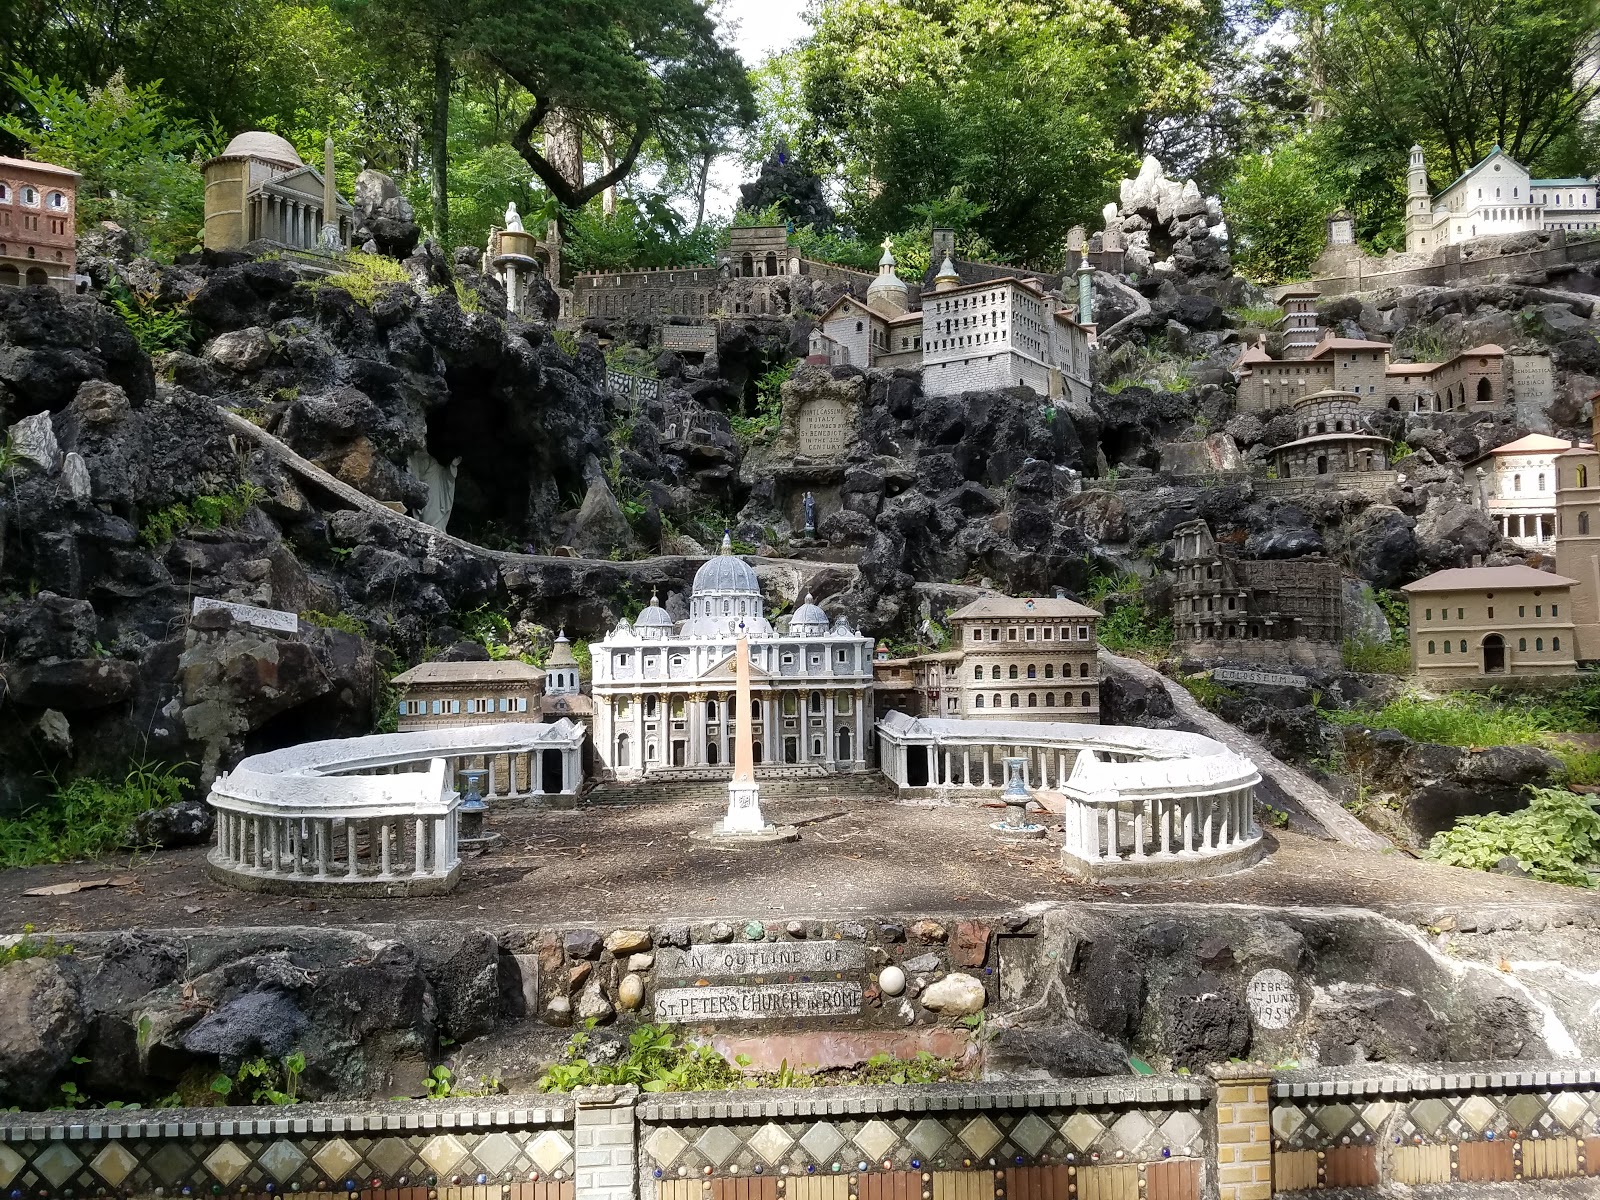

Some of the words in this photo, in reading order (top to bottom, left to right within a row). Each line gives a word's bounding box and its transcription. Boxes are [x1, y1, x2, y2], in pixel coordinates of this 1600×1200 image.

[1221, 670, 1287, 684] COLOSSEUM
[675, 954, 704, 969] AN
[724, 951, 802, 967] OUTLINE
[824, 949, 842, 962] OF
[680, 995, 738, 1014] PETER'S
[742, 991, 799, 1012] CHURCH
[821, 990, 861, 1008] ROME
[1258, 1007, 1291, 1021] 1954
